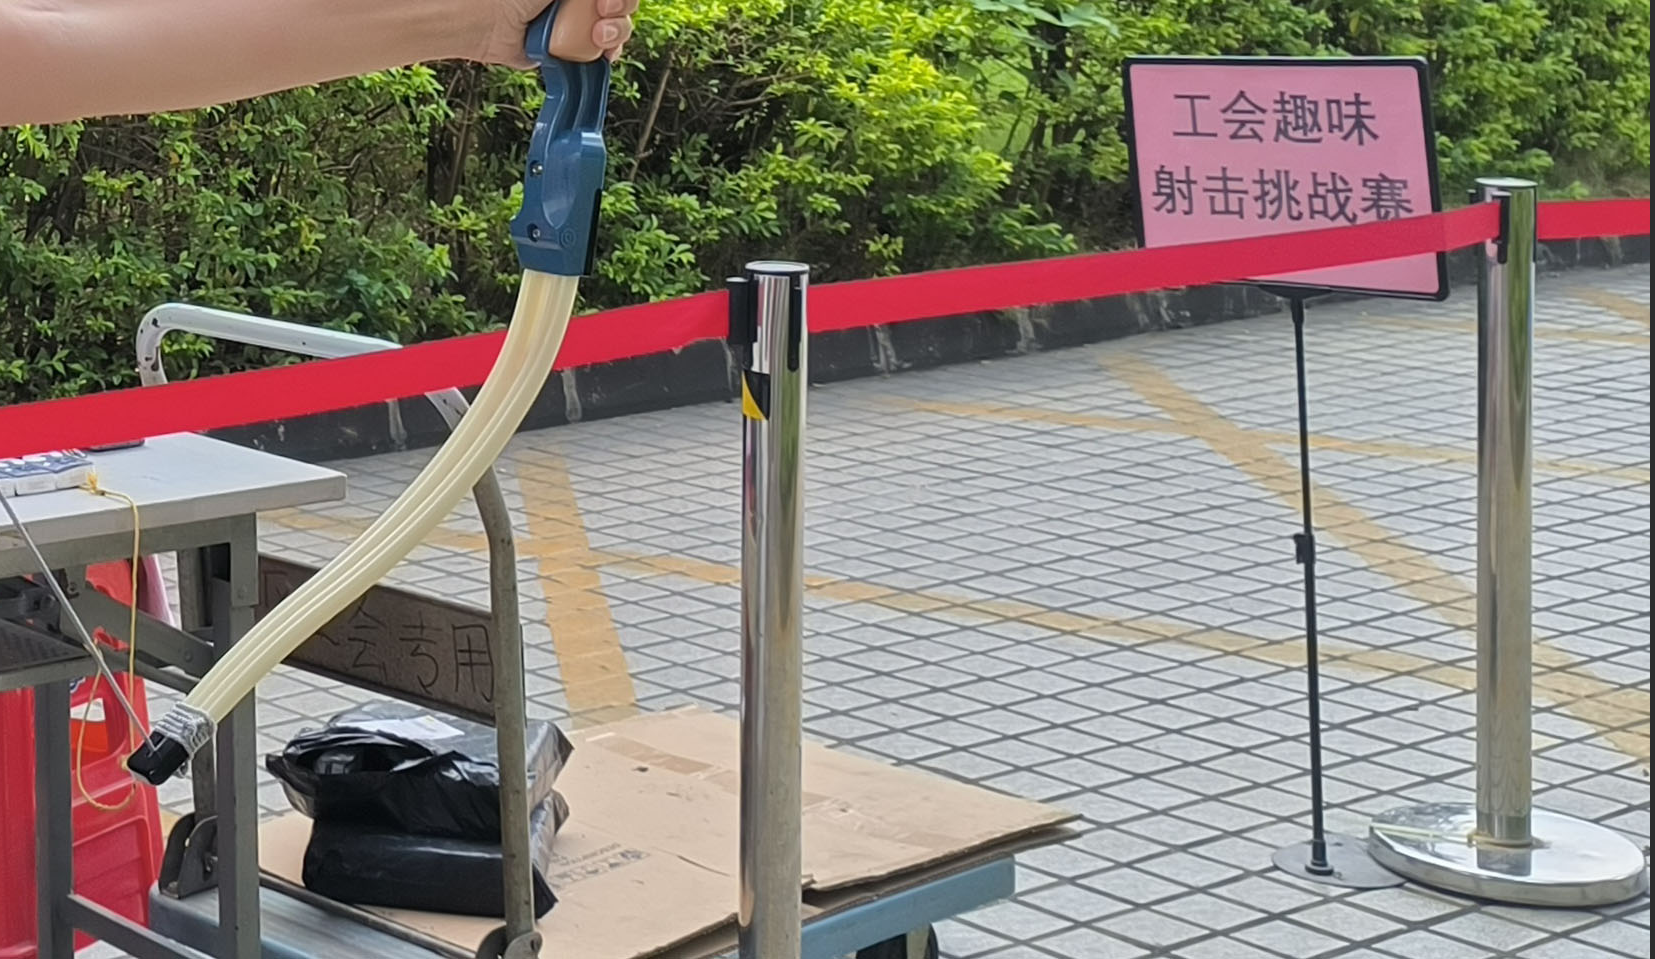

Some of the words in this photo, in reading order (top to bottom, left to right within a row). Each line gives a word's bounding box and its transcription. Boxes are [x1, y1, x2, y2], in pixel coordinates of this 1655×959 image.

[1172, 90, 1380, 146] 工会趣味
[1151, 164, 1414, 226] 射击挑战赛
